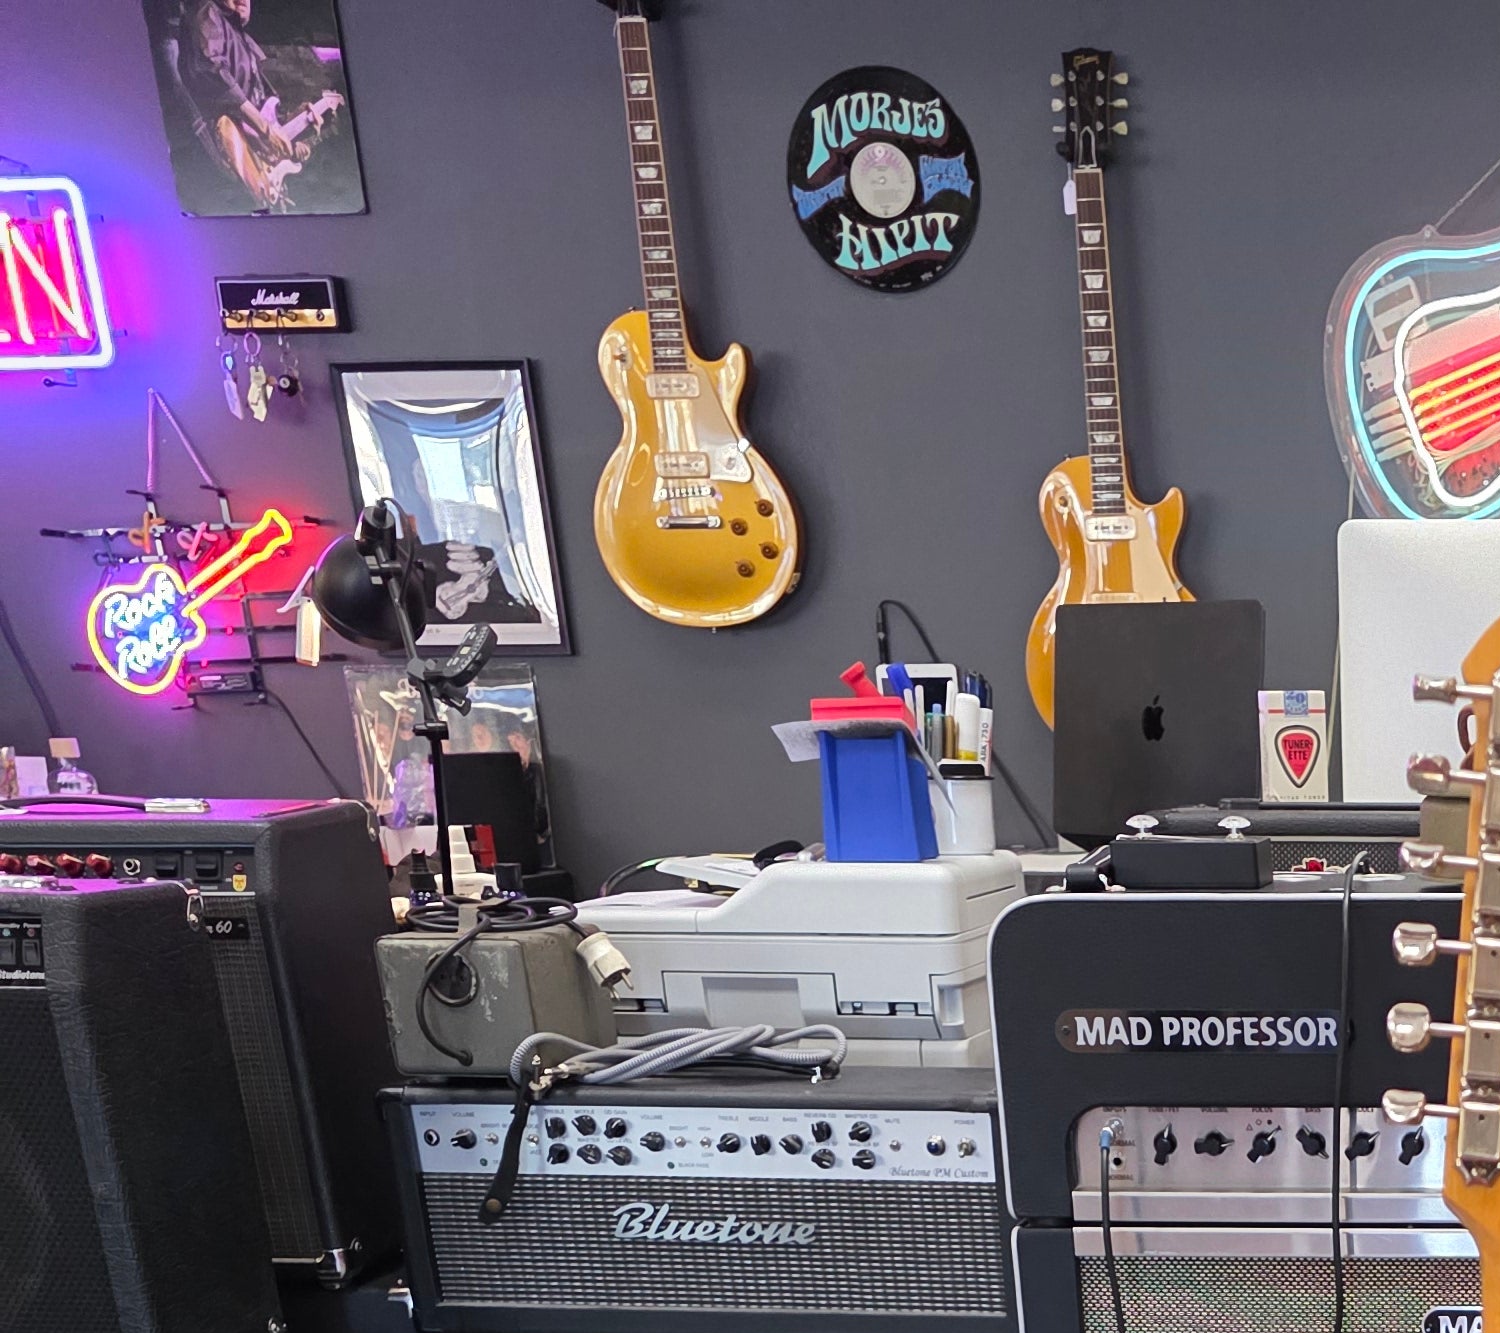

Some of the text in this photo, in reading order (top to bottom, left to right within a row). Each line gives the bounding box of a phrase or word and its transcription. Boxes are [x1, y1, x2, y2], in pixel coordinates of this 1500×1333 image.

[806, 92, 946, 180] MORJES
[834, 212, 961, 271] HIPIT
[251, 288, 300, 306] Marshall
[104, 572, 176, 639] Rock
[116, 614, 183, 680] Roll
[1288, 750, 1308, 761] ETTE
[215, 920, 233, 934] 60
[1074, 1016, 1338, 1047] MAD PROFESSOR
[888, 1166, 931, 1178] Bluetone
[954, 1167, 989, 1179] Custom
[612, 1202, 816, 1245] Bluetone
